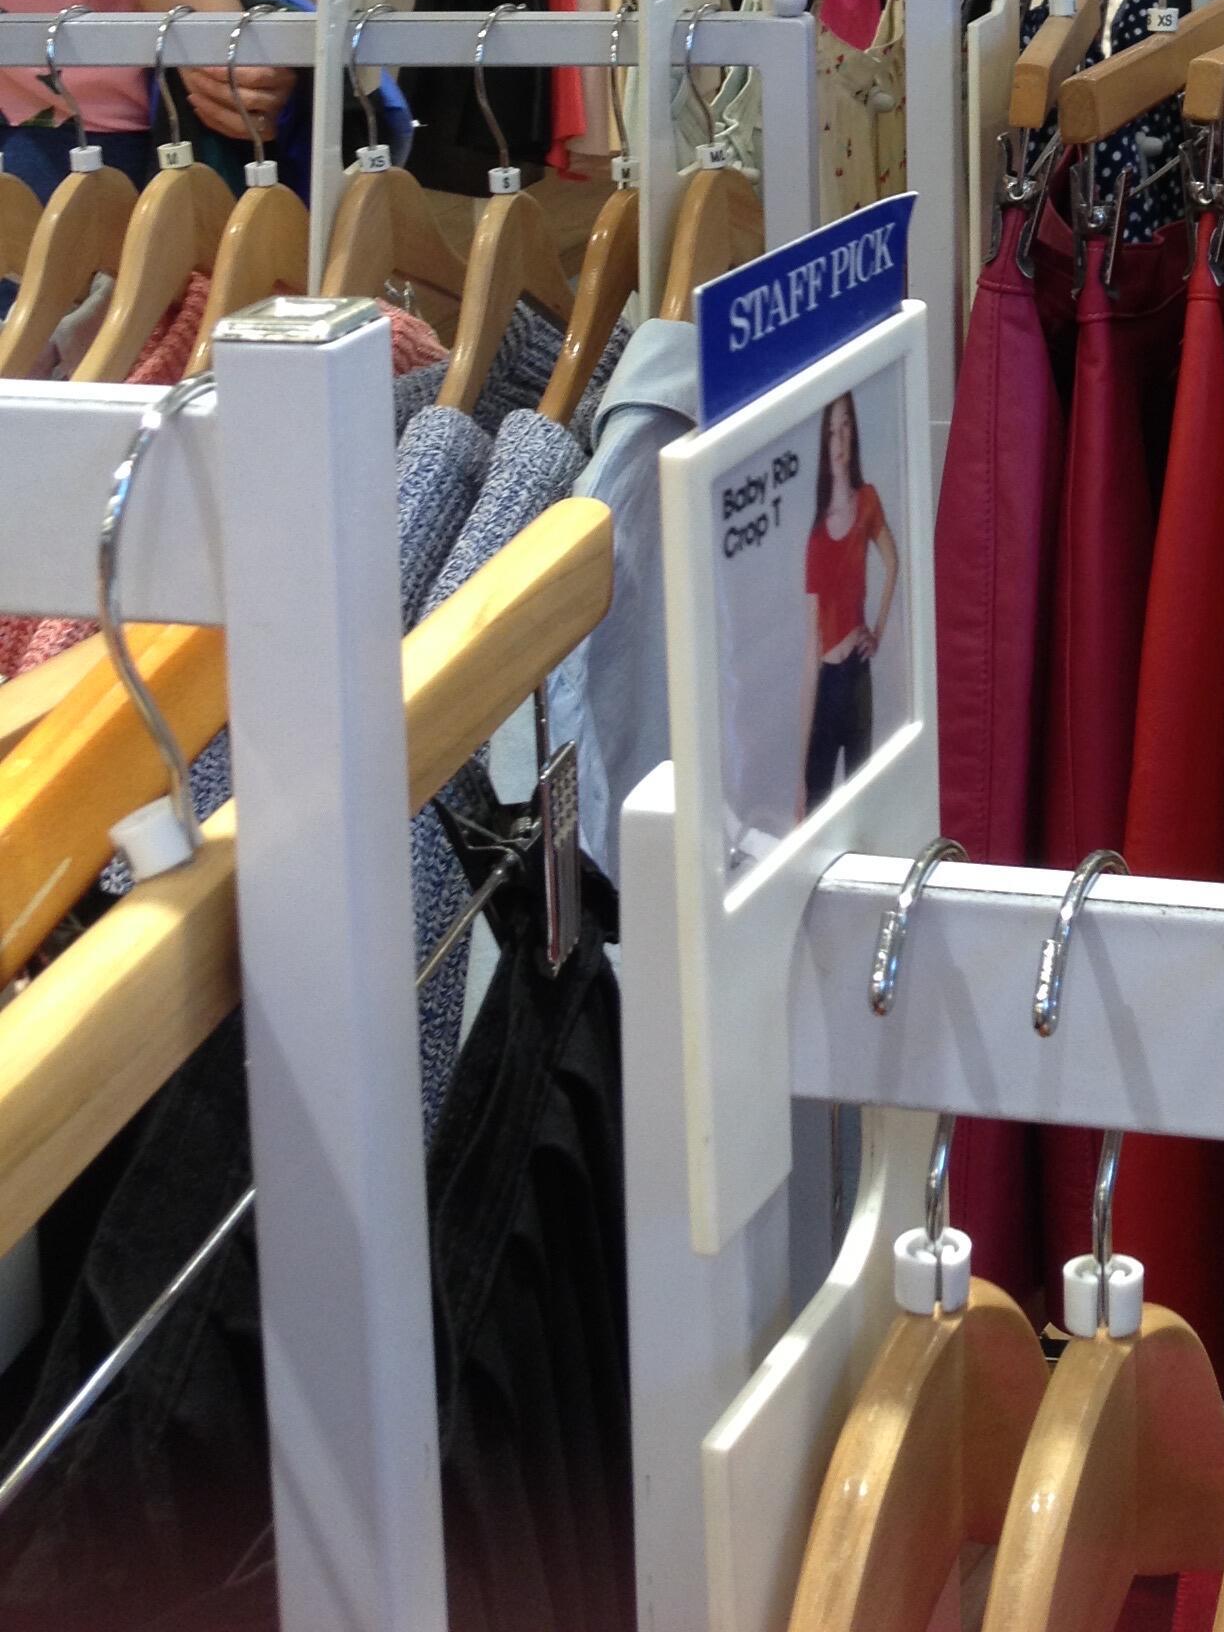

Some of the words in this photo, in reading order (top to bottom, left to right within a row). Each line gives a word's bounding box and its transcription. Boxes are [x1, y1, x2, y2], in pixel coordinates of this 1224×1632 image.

[1157, 14, 1172, 26] XS
[370, 156, 386, 168] XS
[503, 176, 510, 189] S
[728, 255, 827, 353] STAFF
[829, 222, 896, 299] PICK
[723, 472, 768, 521] Baby
[772, 450, 799, 489] Rib
[723, 513, 768, 559] Crop
[772, 495, 782, 527] T
